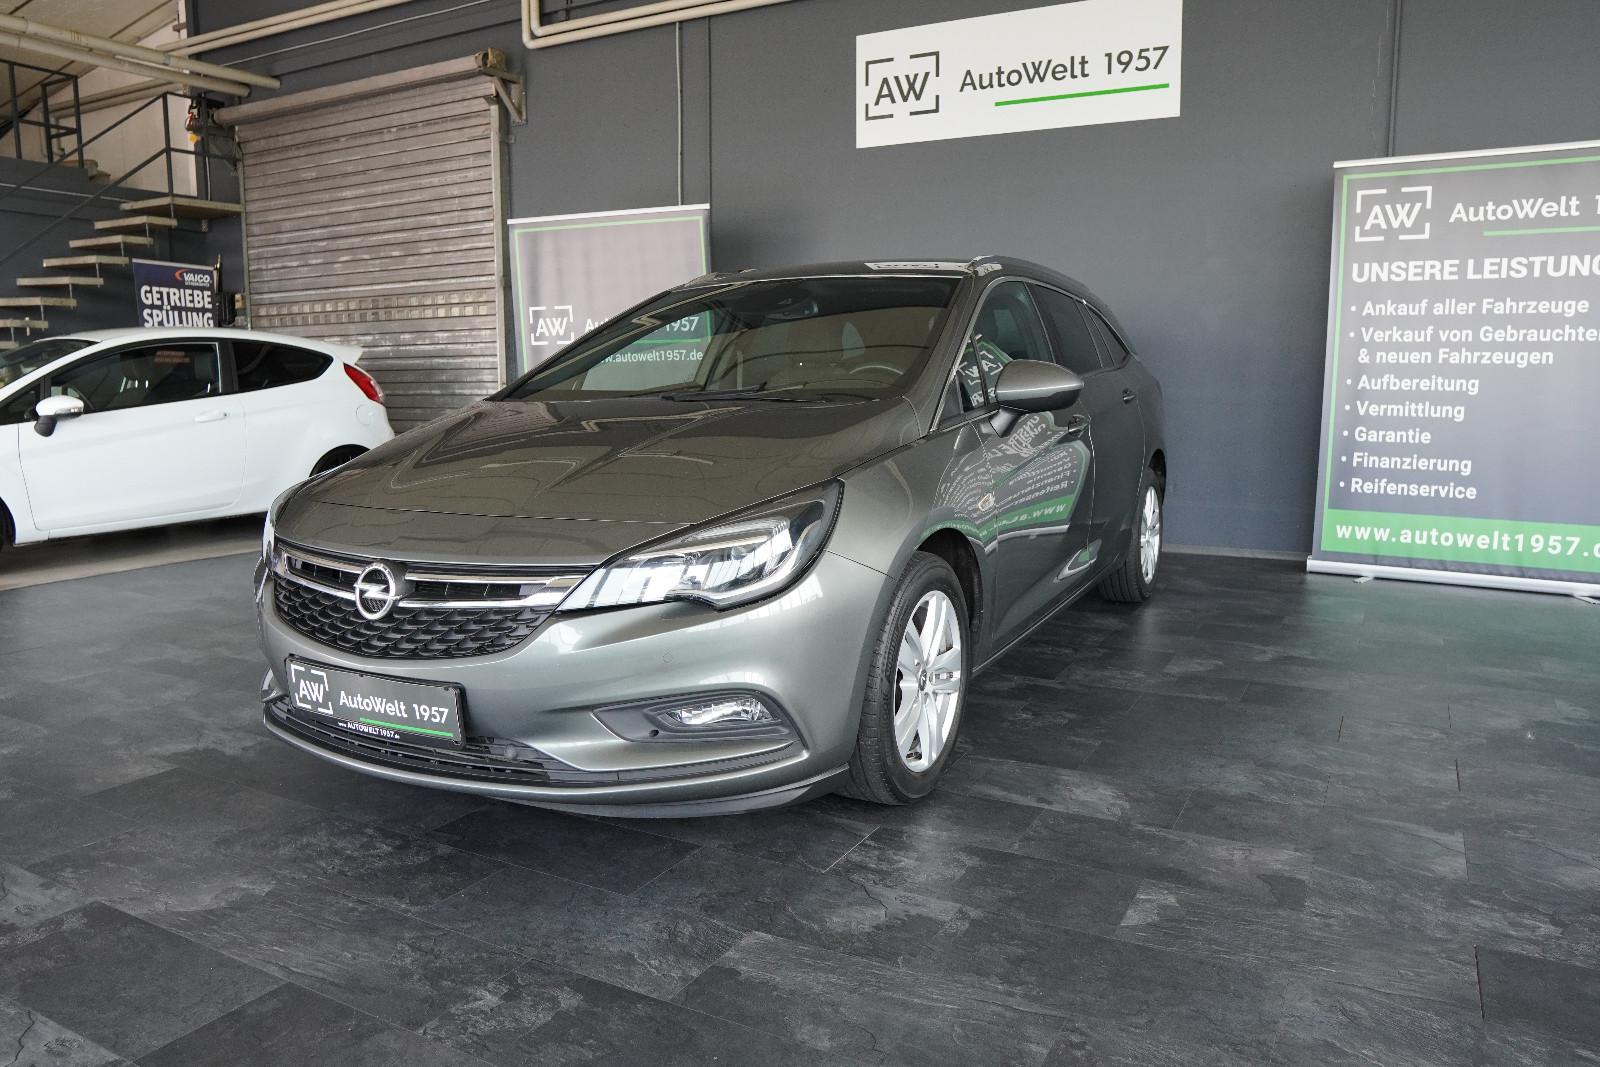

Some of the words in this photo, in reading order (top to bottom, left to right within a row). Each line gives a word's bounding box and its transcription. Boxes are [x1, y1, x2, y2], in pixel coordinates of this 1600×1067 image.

[959, 55, 1090, 93] AutoWelt
[1103, 45, 1170, 75] 1957
[874, 71, 930, 106] AW
[1364, 202, 1423, 230] AW
[1449, 195, 1580, 223] AutoWelt
[183, 272, 210, 283] VAICO
[1352, 259, 1460, 283] UNSERE
[140, 284, 213, 309] GETRIEBE
[1361, 299, 1428, 316] Ankauf
[1432, 298, 1476, 315] aller
[1482, 297, 1589, 317] Fahrzeuge
[142, 305, 214, 328] SPÜLUNG
[535, 317, 568, 337] AW
[1360, 325, 1434, 343] Verkauf
[1439, 328, 1473, 342] von
[1479, 324, 1600, 343] Gebrauchte
[601, 348, 703, 364] w.autowelt1957.de
[1357, 348, 1370, 363] &
[1376, 351, 1432, 364] neuen
[1438, 348, 1554, 368] Fahrzeugen
[1357, 374, 1480, 395] Aufbereitung
[1356, 400, 1465, 422] Vermittlung
[1354, 426, 1431, 444] Garantie
[1352, 452, 1472, 476] Finanzierung
[1350, 477, 1477, 500] Reifenservice
[299, 679, 324, 703] AW
[339, 690, 408, 718] AutoWelt
[412, 703, 449, 724] 1957
